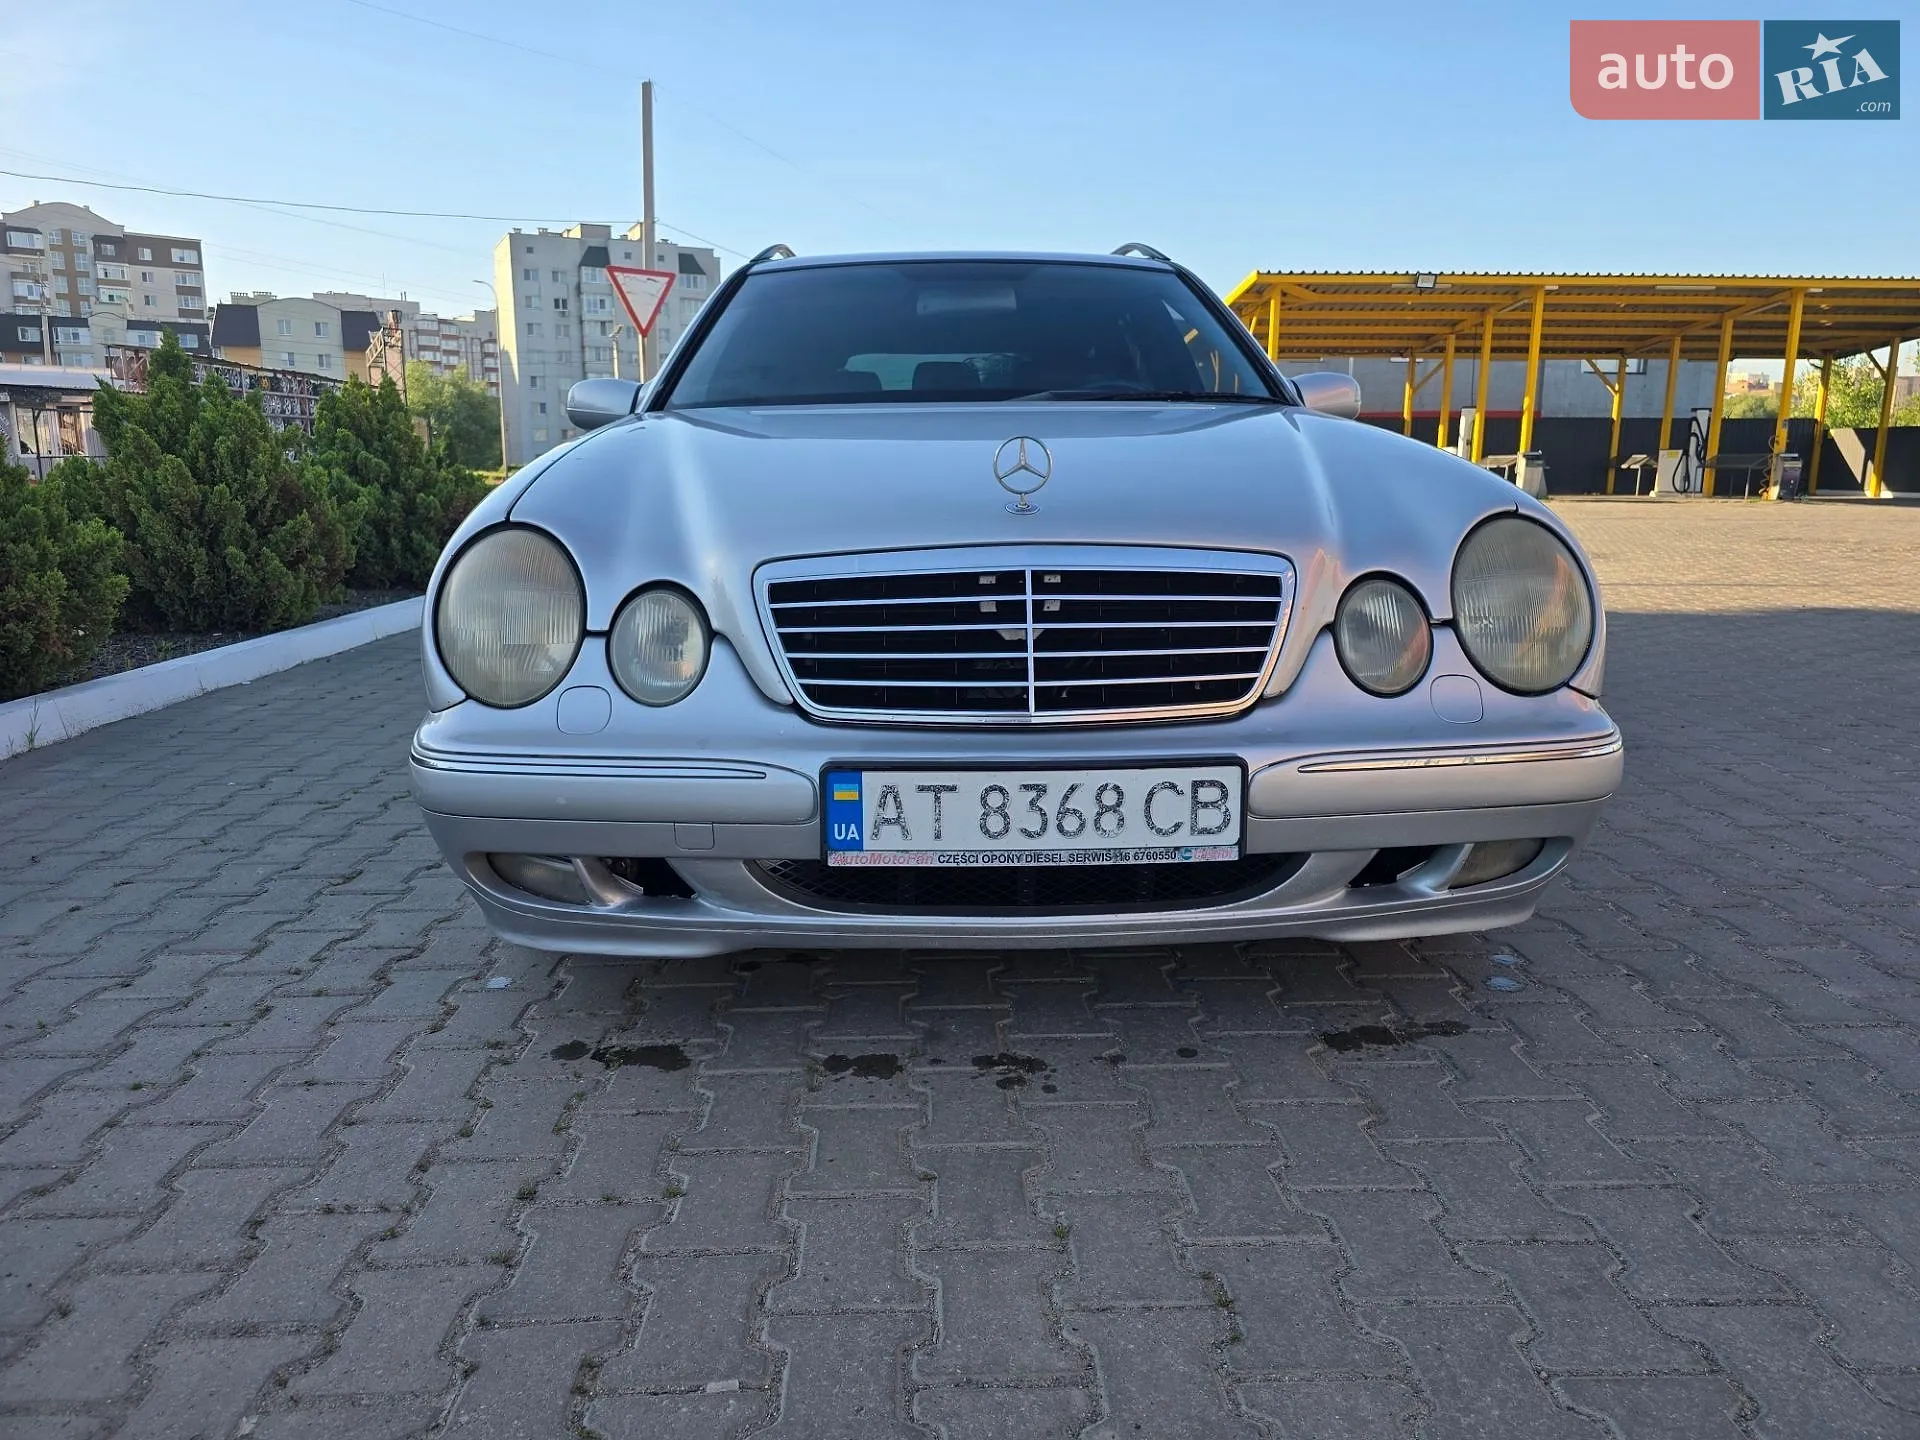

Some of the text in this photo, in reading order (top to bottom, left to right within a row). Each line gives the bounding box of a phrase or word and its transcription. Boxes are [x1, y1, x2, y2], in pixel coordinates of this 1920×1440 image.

[870, 779, 1233, 841] AT 8368 CB
[833, 822, 860, 841] UA
[937, 853, 979, 867] CZĘŚCI
[981, 853, 1024, 865] OPONY
[1025, 852, 1066, 864] DIESEL
[1068, 851, 1112, 863] SERWIS
[1133, 850, 1177, 861] 6760550
